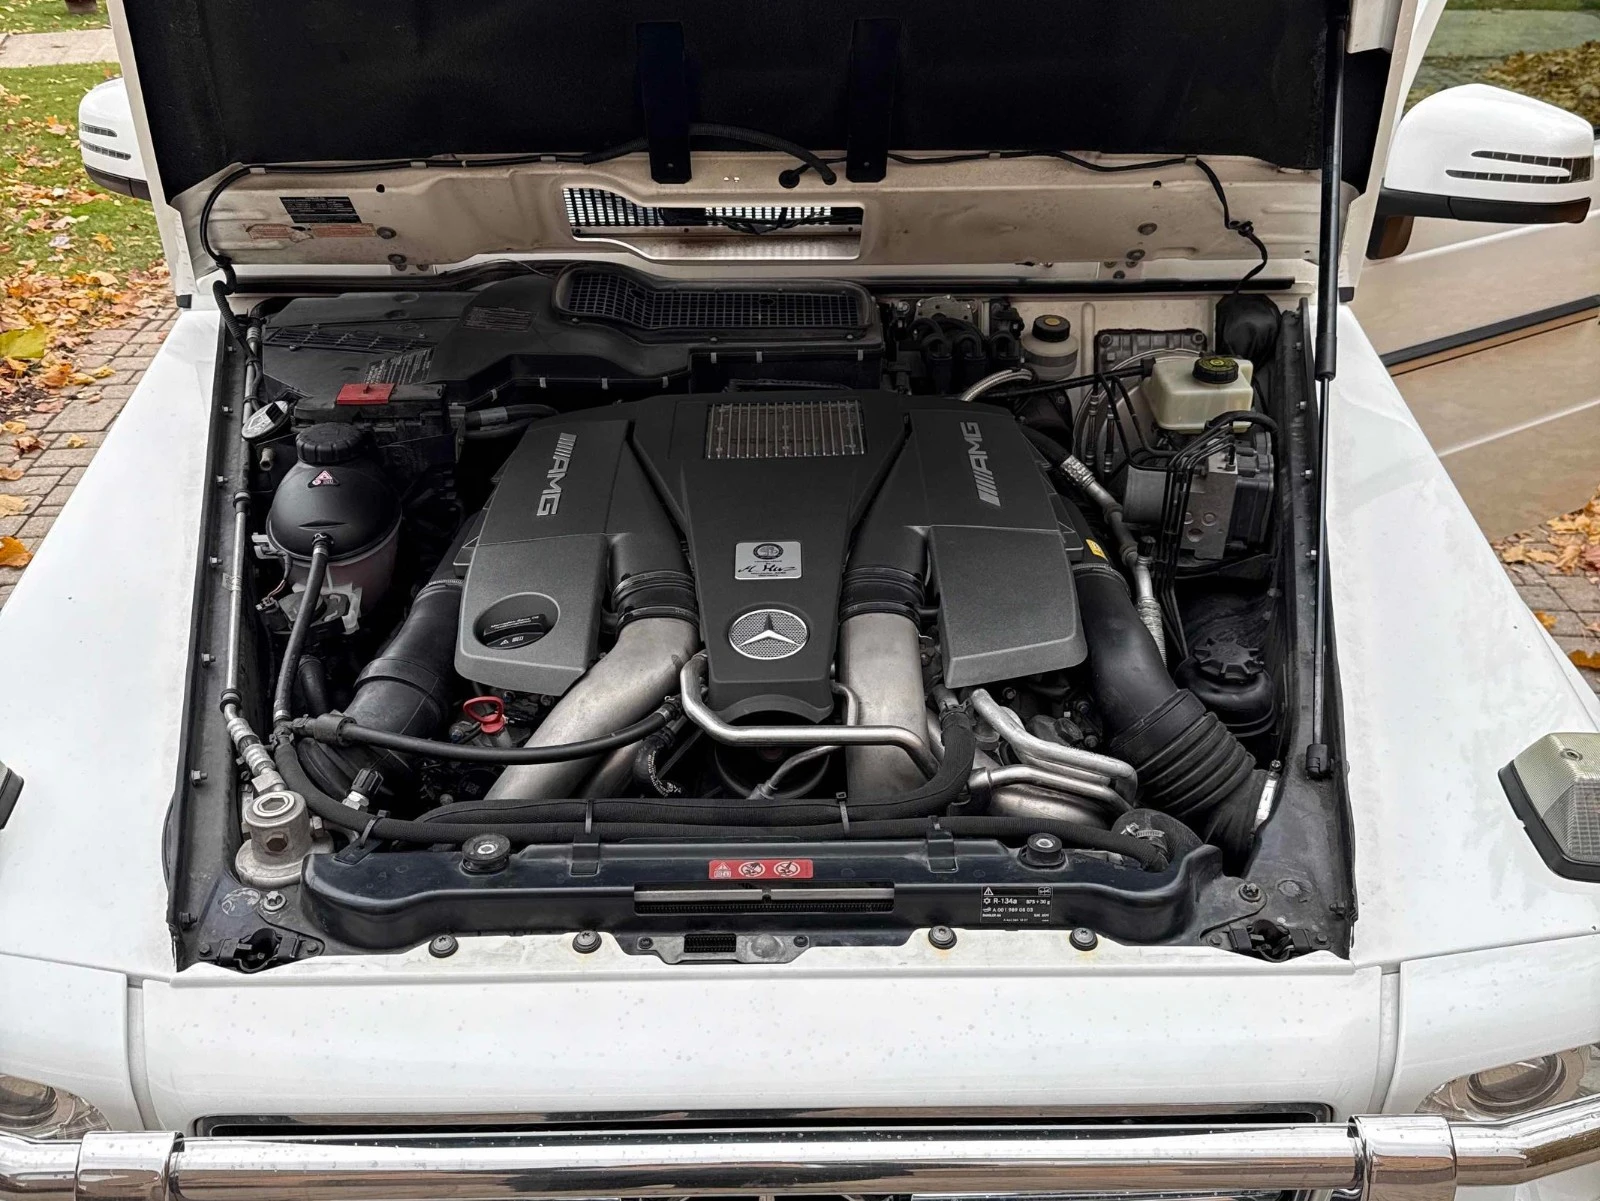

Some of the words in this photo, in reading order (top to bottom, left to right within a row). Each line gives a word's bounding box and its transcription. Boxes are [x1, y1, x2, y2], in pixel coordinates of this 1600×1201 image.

[960, 421, 993, 477] AMG
[536, 453, 571, 516] AMG
[993, 897, 1018, 905] R-134a
